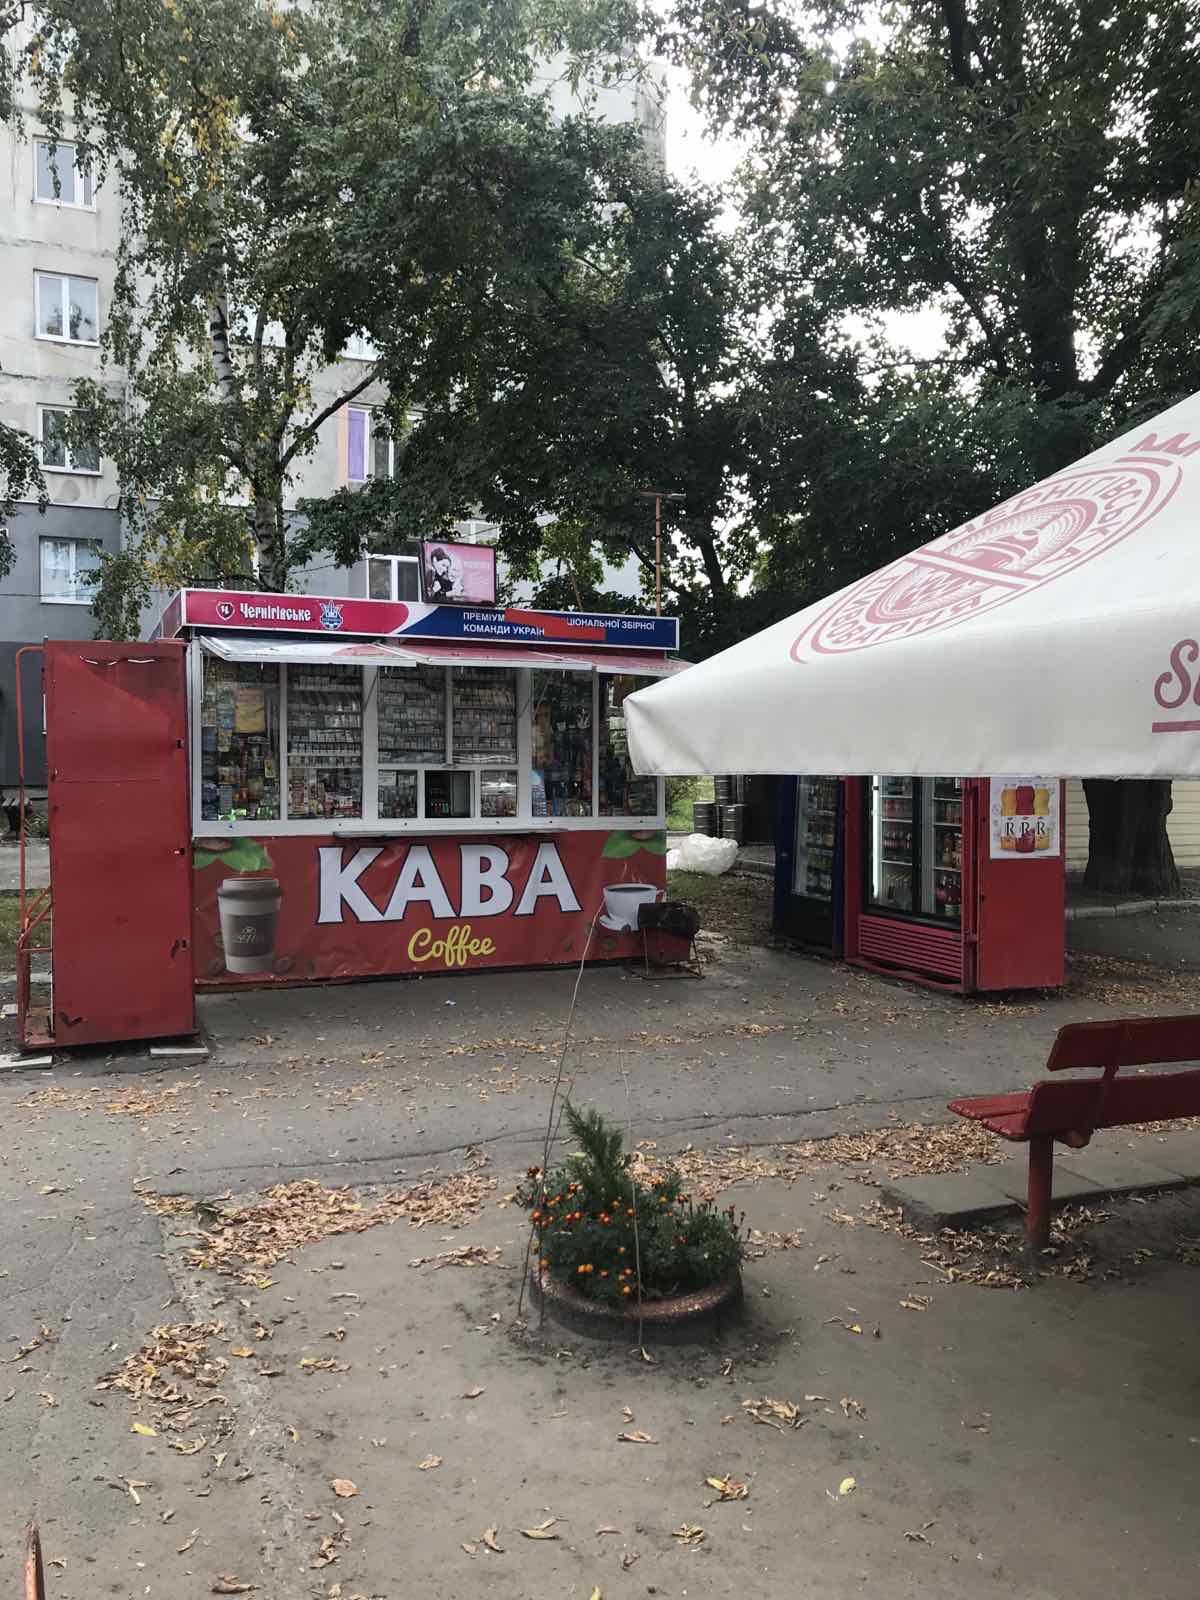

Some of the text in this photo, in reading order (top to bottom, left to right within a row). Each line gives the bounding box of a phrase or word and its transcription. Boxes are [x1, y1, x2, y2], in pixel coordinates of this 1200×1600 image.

[240, 602, 312, 622] Чернігівське
[463, 611, 656, 631] ПРЕМІУМ ЦІОНАЛЬНОЇ ЗБІРНОЇ
[826, 575, 983, 646] ПИВОВАРНЯ
[463, 623, 511, 635] КОМАНДИ
[316, 841, 582, 923] КАВА
[407, 924, 496, 968] Coffee
